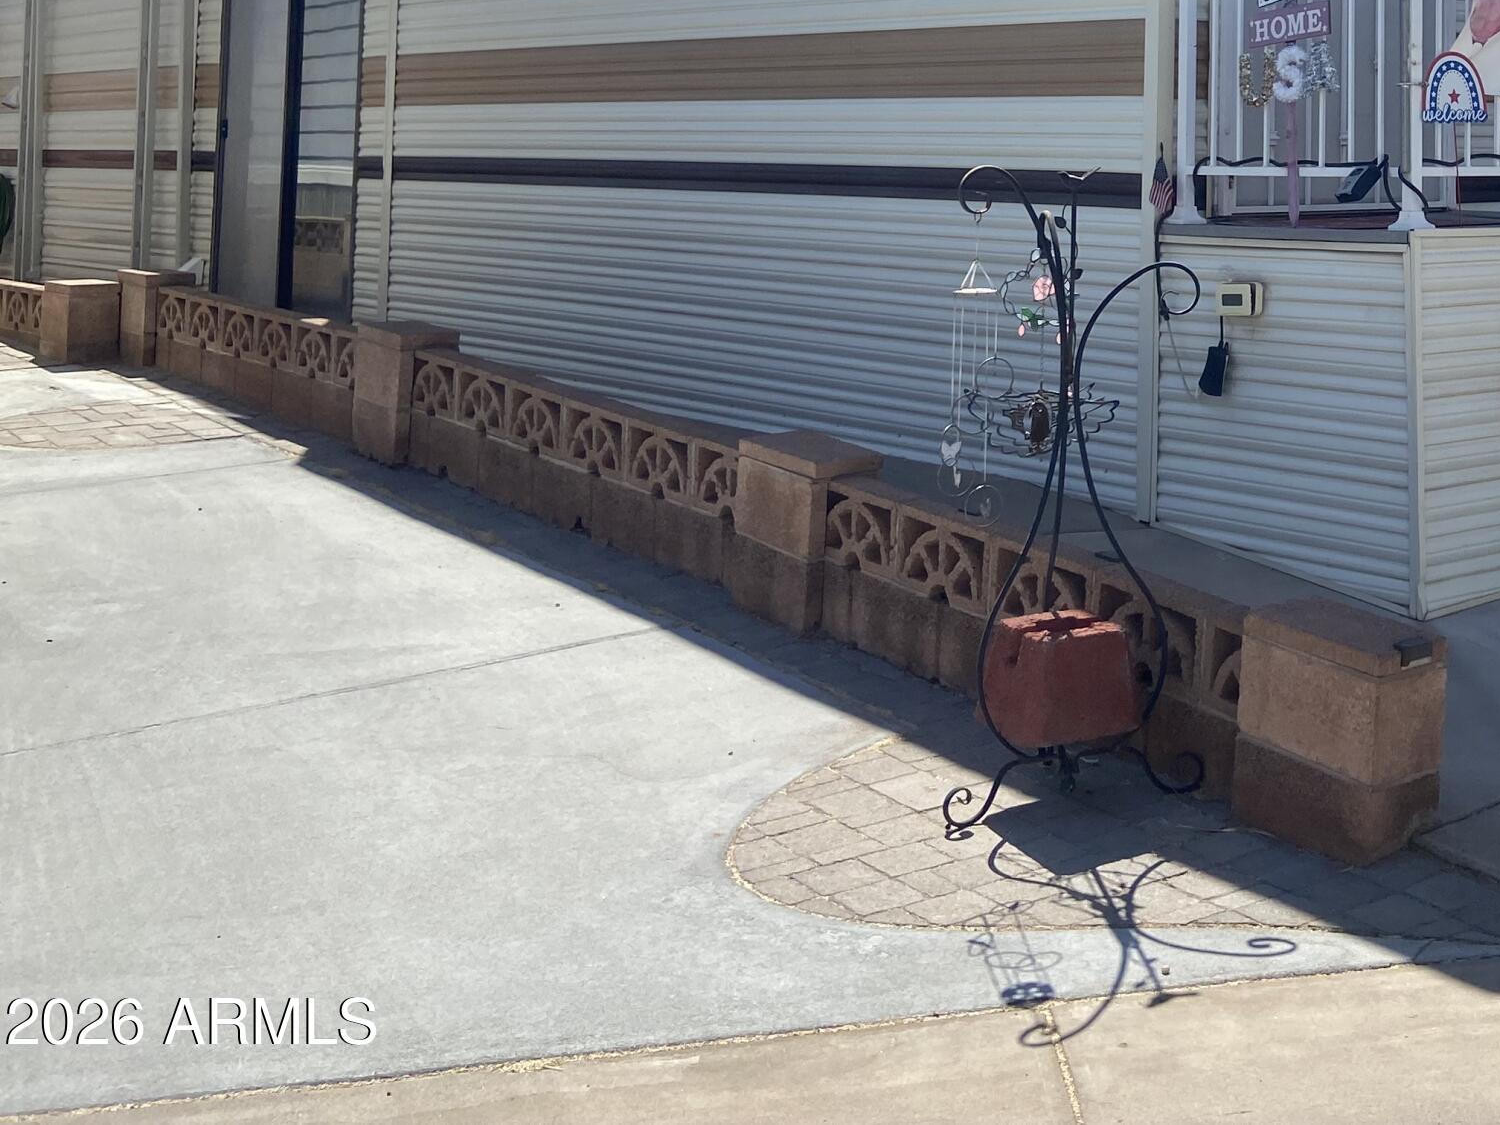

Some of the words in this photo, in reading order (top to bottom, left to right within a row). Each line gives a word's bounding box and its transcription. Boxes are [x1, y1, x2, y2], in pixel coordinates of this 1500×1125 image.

[1254, 8, 1323, 43] HOME
[1239, 41, 1340, 107] USA
[1422, 103, 1488, 122] welcome
